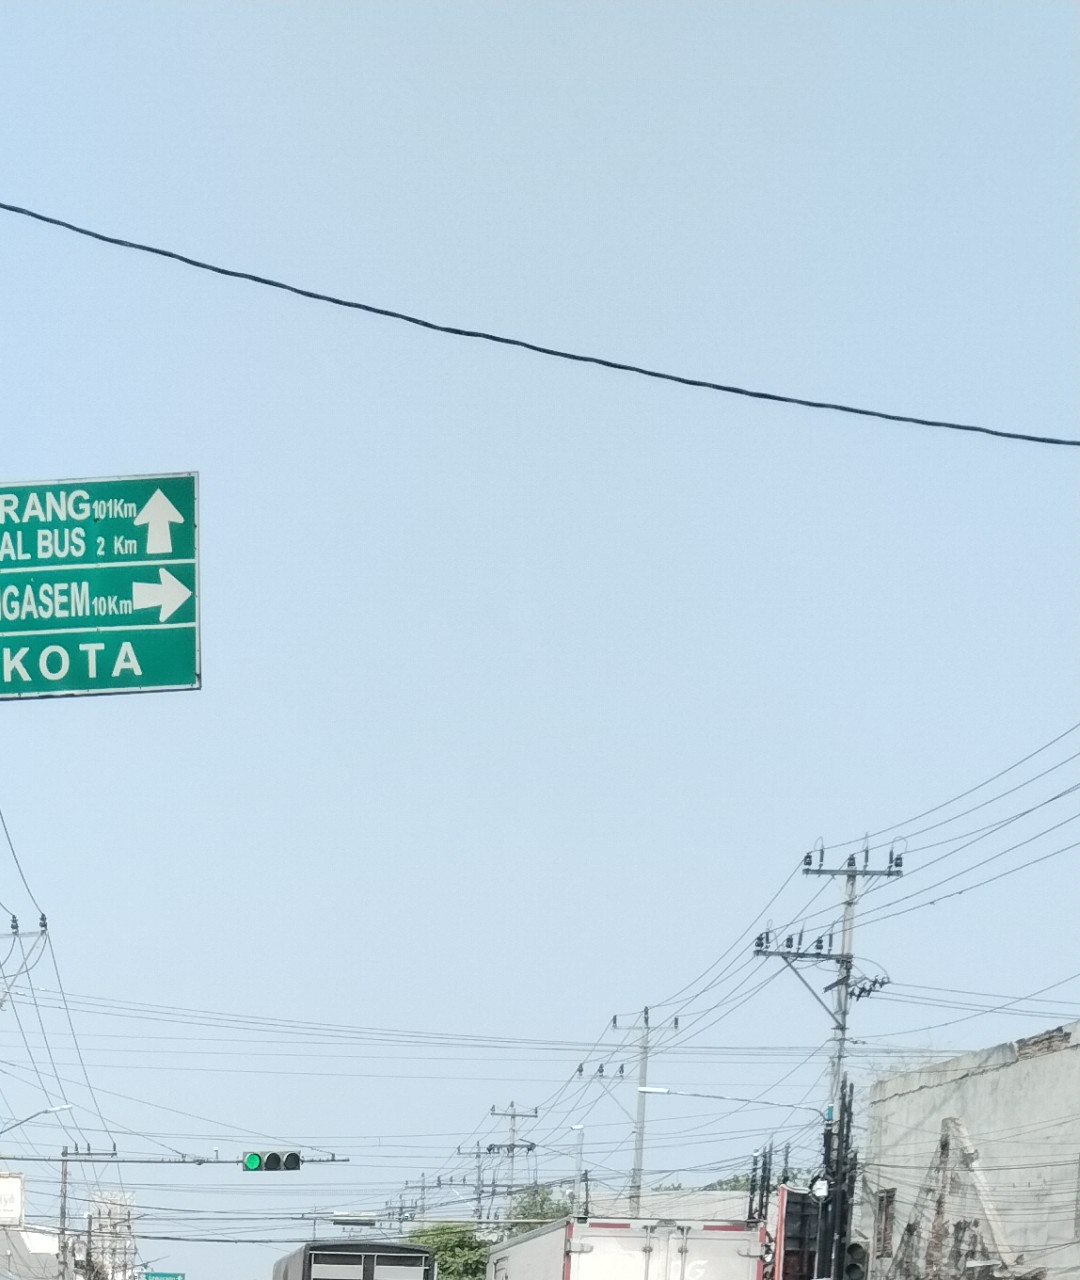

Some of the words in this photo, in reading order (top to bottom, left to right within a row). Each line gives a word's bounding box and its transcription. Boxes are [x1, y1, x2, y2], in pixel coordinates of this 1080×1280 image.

[37, 527, 86, 559] BUS
[96, 536, 105, 556] 2
[114, 535, 138, 555] Km
[2, 641, 143, 682] KOTA
